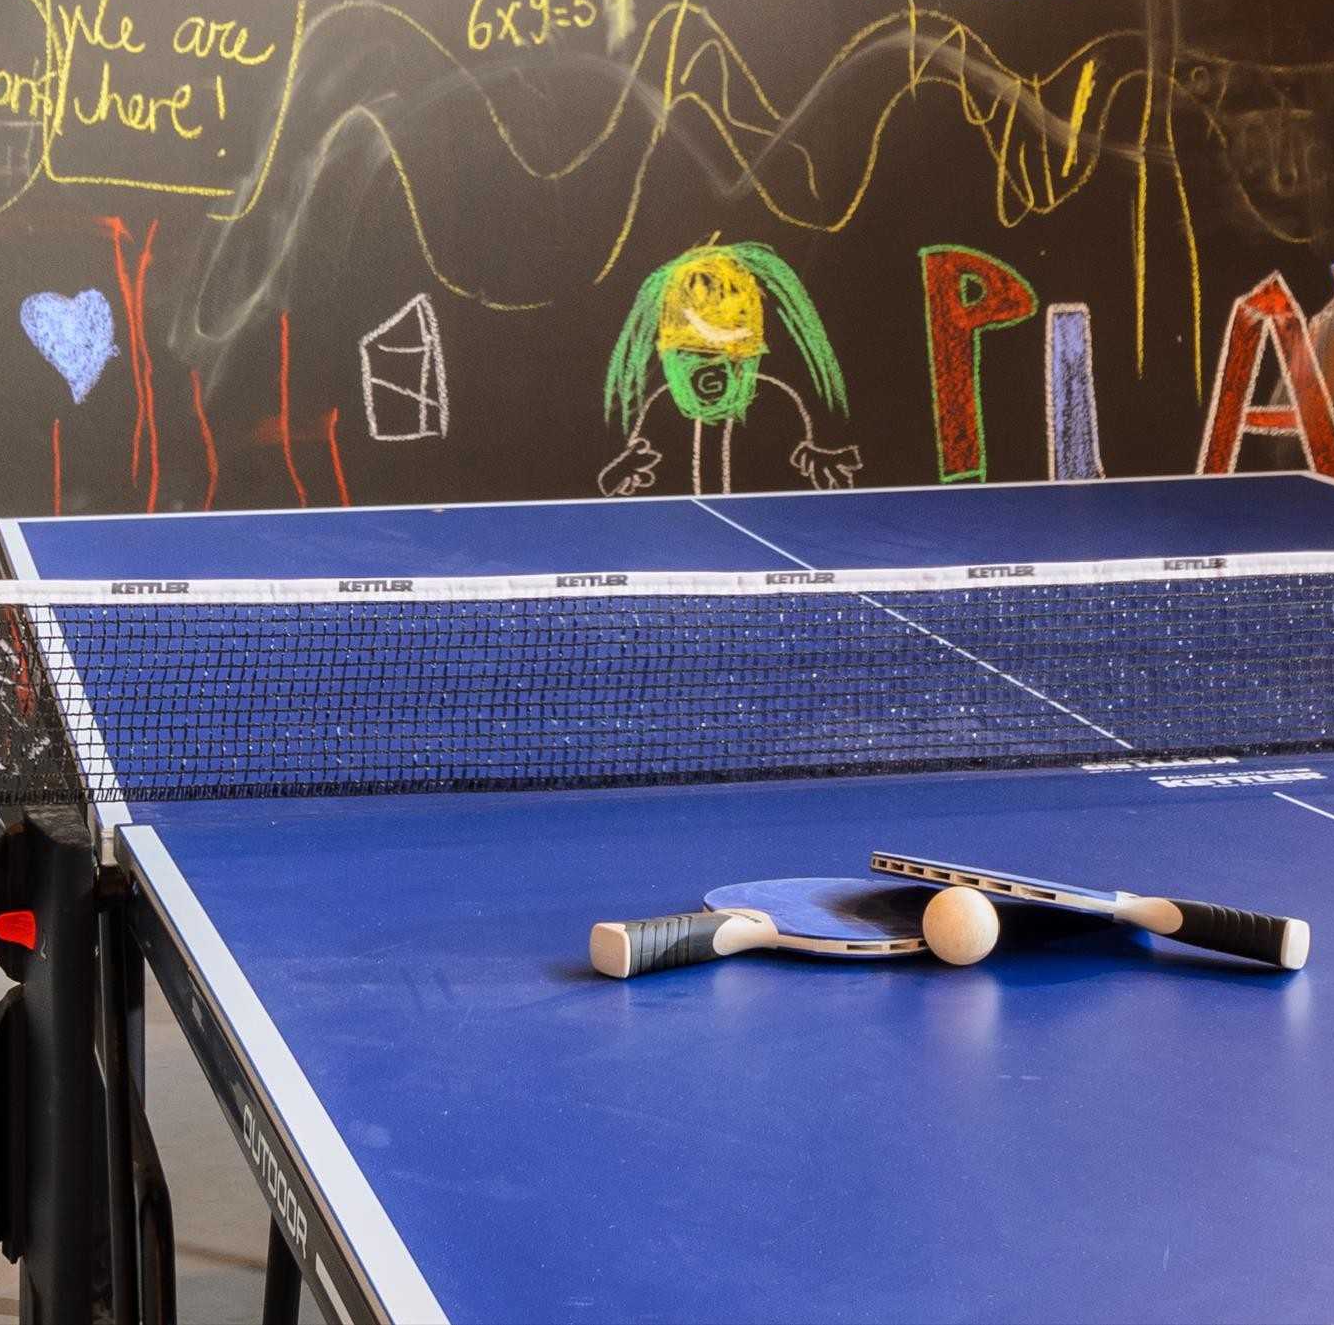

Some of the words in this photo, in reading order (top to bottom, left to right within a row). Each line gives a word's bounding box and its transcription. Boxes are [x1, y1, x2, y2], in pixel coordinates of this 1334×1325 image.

[173, 15, 276, 65] are
[74, 62, 230, 158] here!
[1163, 557, 1228, 572] KETTLER
[765, 571, 836, 586] KETTLER
[967, 565, 1035, 580] KETTLER
[110, 581, 190, 596] KETTLER
[338, 579, 414, 594] KETTLER
[555, 574, 629, 589] KETTLER
[243, 1104, 308, 1260] OUTDOOR
